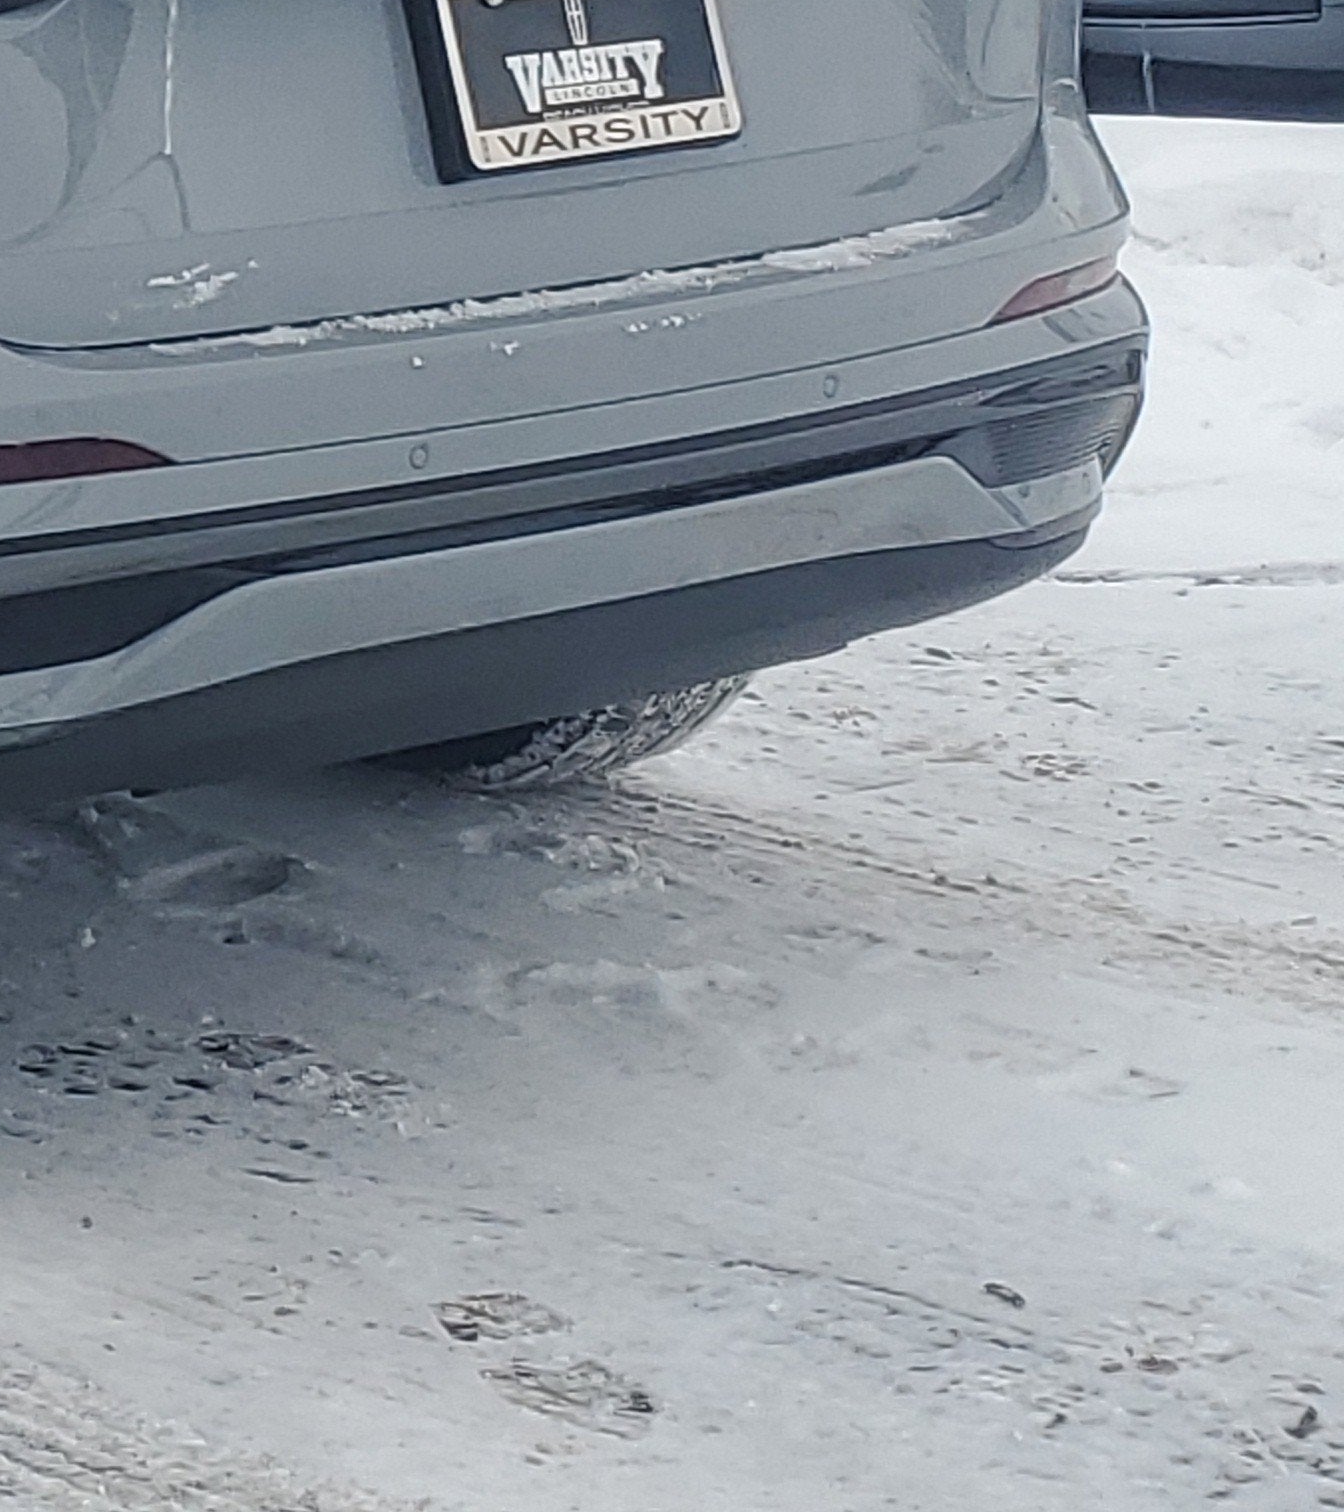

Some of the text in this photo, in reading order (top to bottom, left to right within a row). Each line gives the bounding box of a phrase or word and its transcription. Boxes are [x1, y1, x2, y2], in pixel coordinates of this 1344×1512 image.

[504, 38, 664, 114] VARSITY
[553, 84, 630, 102] LINCOLN
[497, 106, 710, 158] VARSITY
